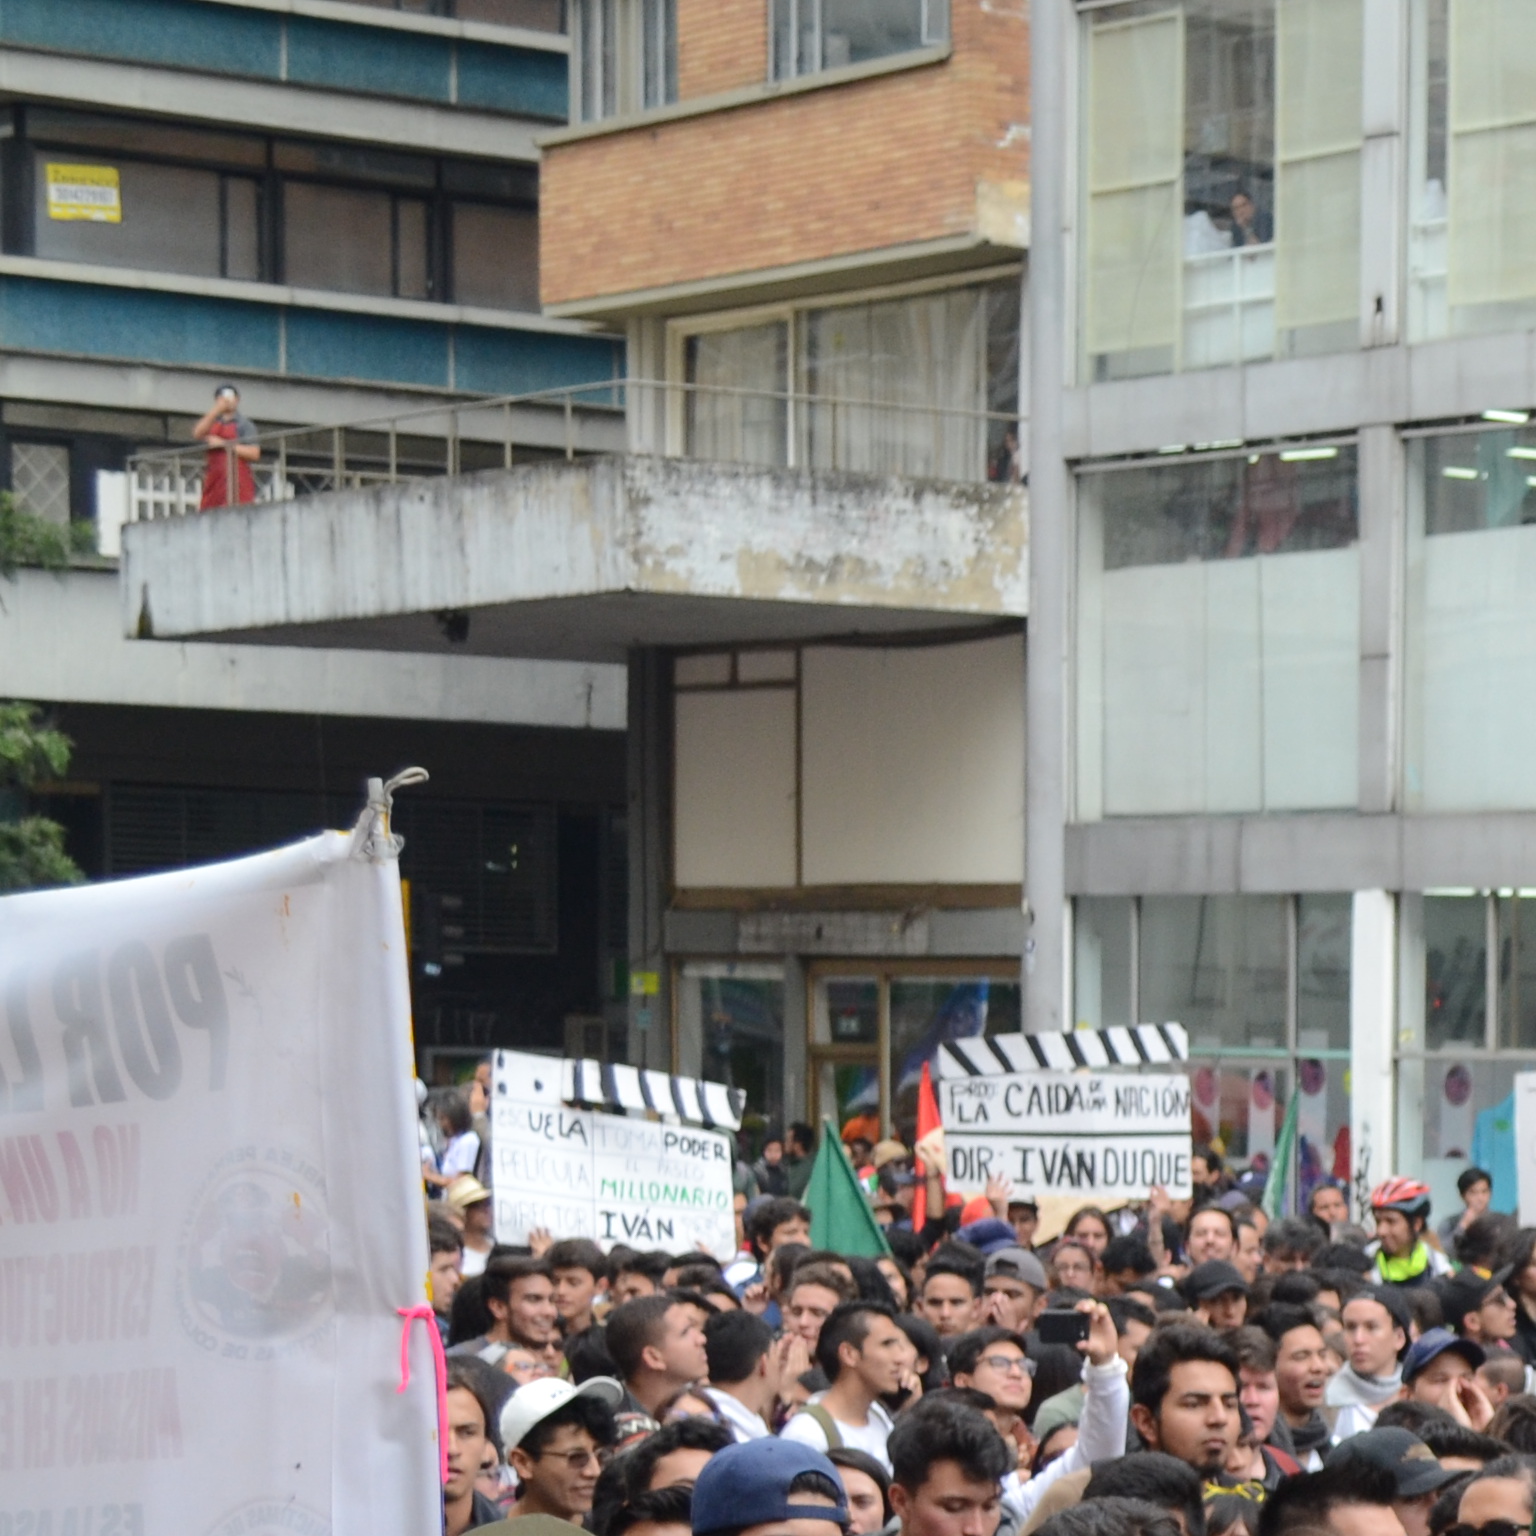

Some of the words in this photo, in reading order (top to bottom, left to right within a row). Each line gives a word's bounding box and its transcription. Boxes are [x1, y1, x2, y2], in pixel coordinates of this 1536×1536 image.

[958, 1101, 990, 1124] LA
[664, 1131, 727, 1162] PODER
[1013, 1143, 1096, 1189] IVÁN
[1103, 1146, 1188, 1188] DUQUE
[600, 1176, 728, 1210] MILLONARIO
[598, 1206, 676, 1242] IVÁN
